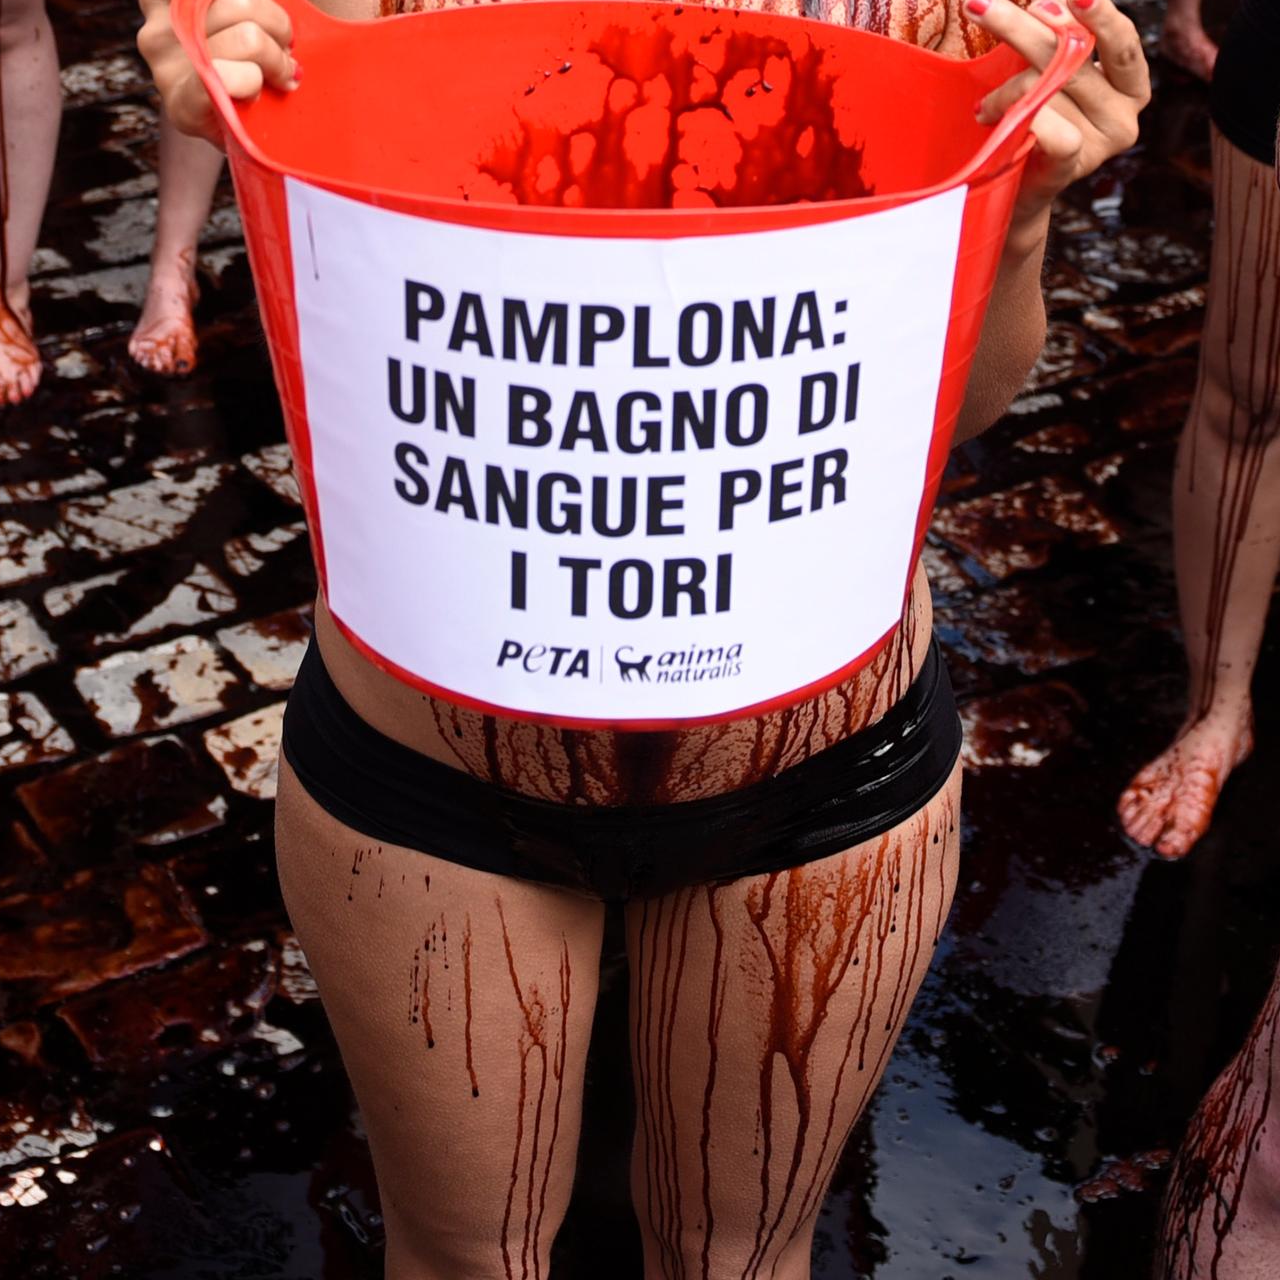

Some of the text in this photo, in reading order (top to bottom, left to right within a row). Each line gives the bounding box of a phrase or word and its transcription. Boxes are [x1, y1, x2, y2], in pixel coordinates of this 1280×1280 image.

[403, 278, 849, 369] PAMPLONA:
[386, 356, 862, 455] UN BAGNO DI
[392, 442, 850, 538] SANGUE PER
[509, 550, 734, 621] I TORI
[655, 660, 743, 684] naturalis
[656, 642, 743, 668] anima
